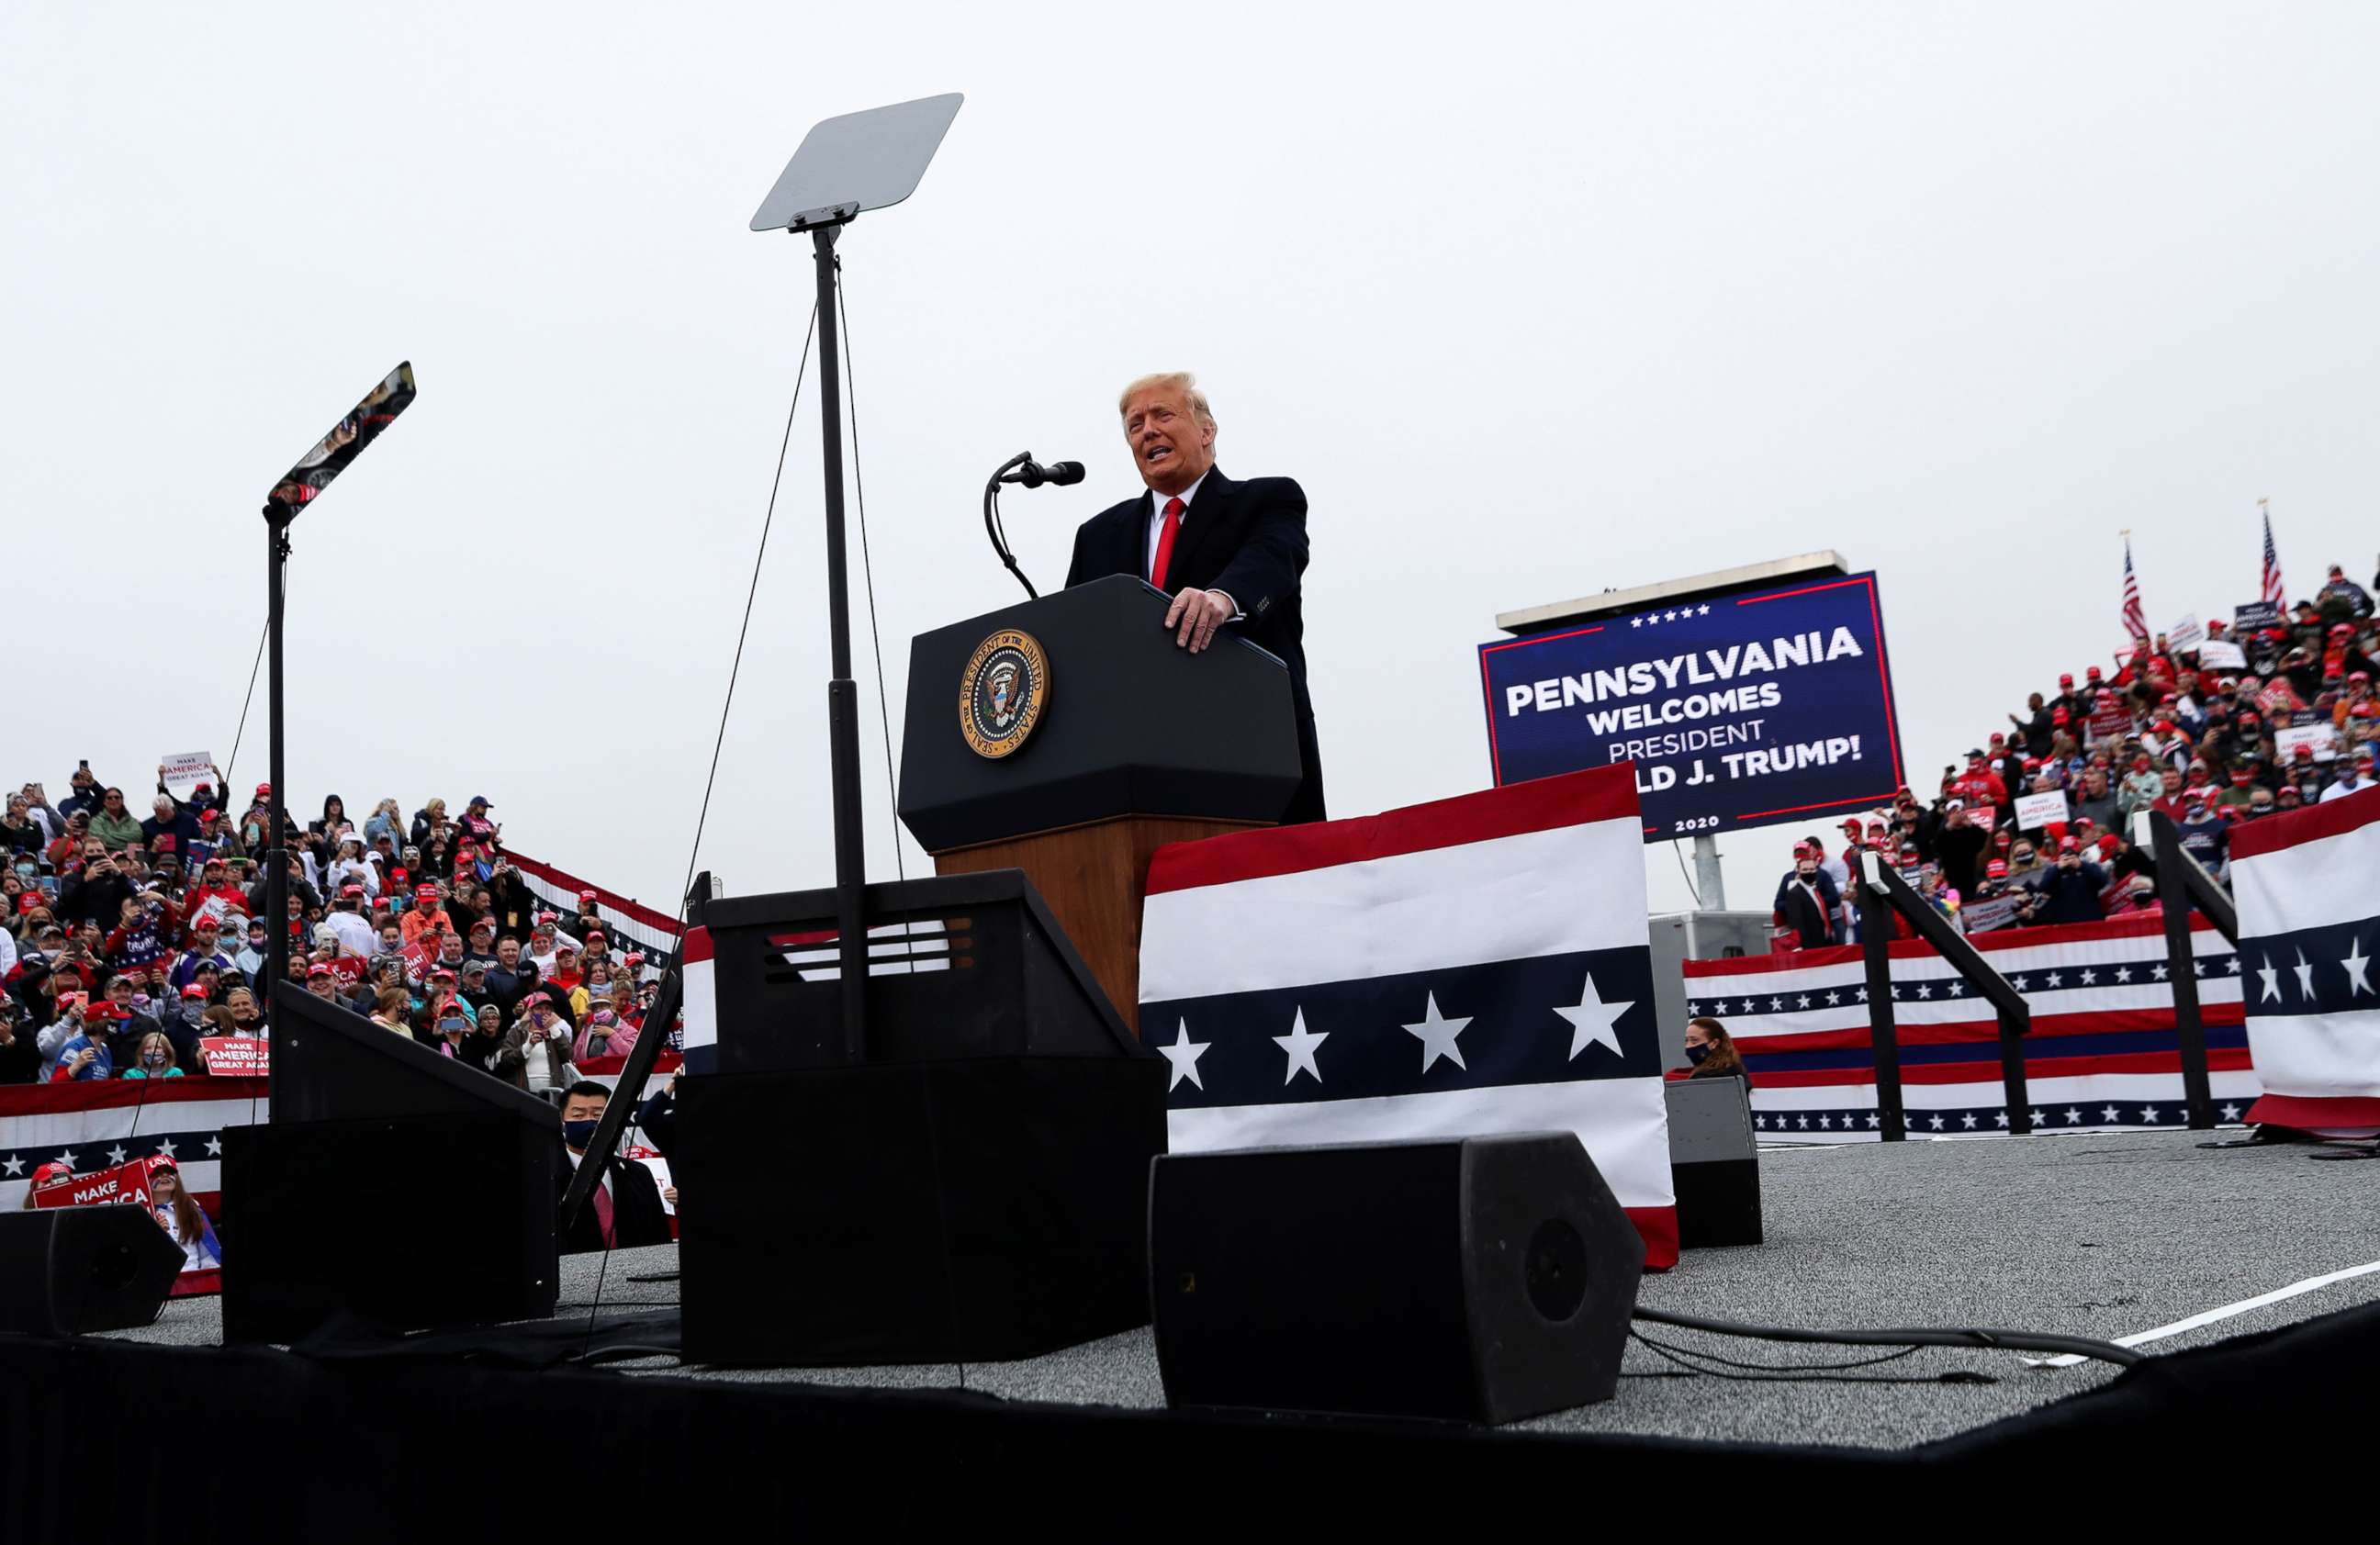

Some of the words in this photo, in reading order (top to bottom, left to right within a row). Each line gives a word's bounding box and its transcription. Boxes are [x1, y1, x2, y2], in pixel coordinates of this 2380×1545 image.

[962, 636, 1000, 701] PRESIDENT
[1024, 643, 1043, 691] UNITED
[1506, 626, 1864, 718] PENNSYLVANIA
[1007, 704, 1038, 748] STATES
[1586, 682, 1782, 736] WELCOMES
[972, 733, 994, 754] SEAL
[1609, 719, 1765, 764] PRESIDENT
[1686, 759, 1715, 786] J.
[1721, 734, 1863, 779] TRUMP!
[167, 763, 211, 775] AMERICA
[1675, 815, 1720, 833] 2020
[223, 1042, 253, 1051] MAKE
[149, 1157, 172, 1169] USA
[73, 1180, 118, 1204] MAKE
